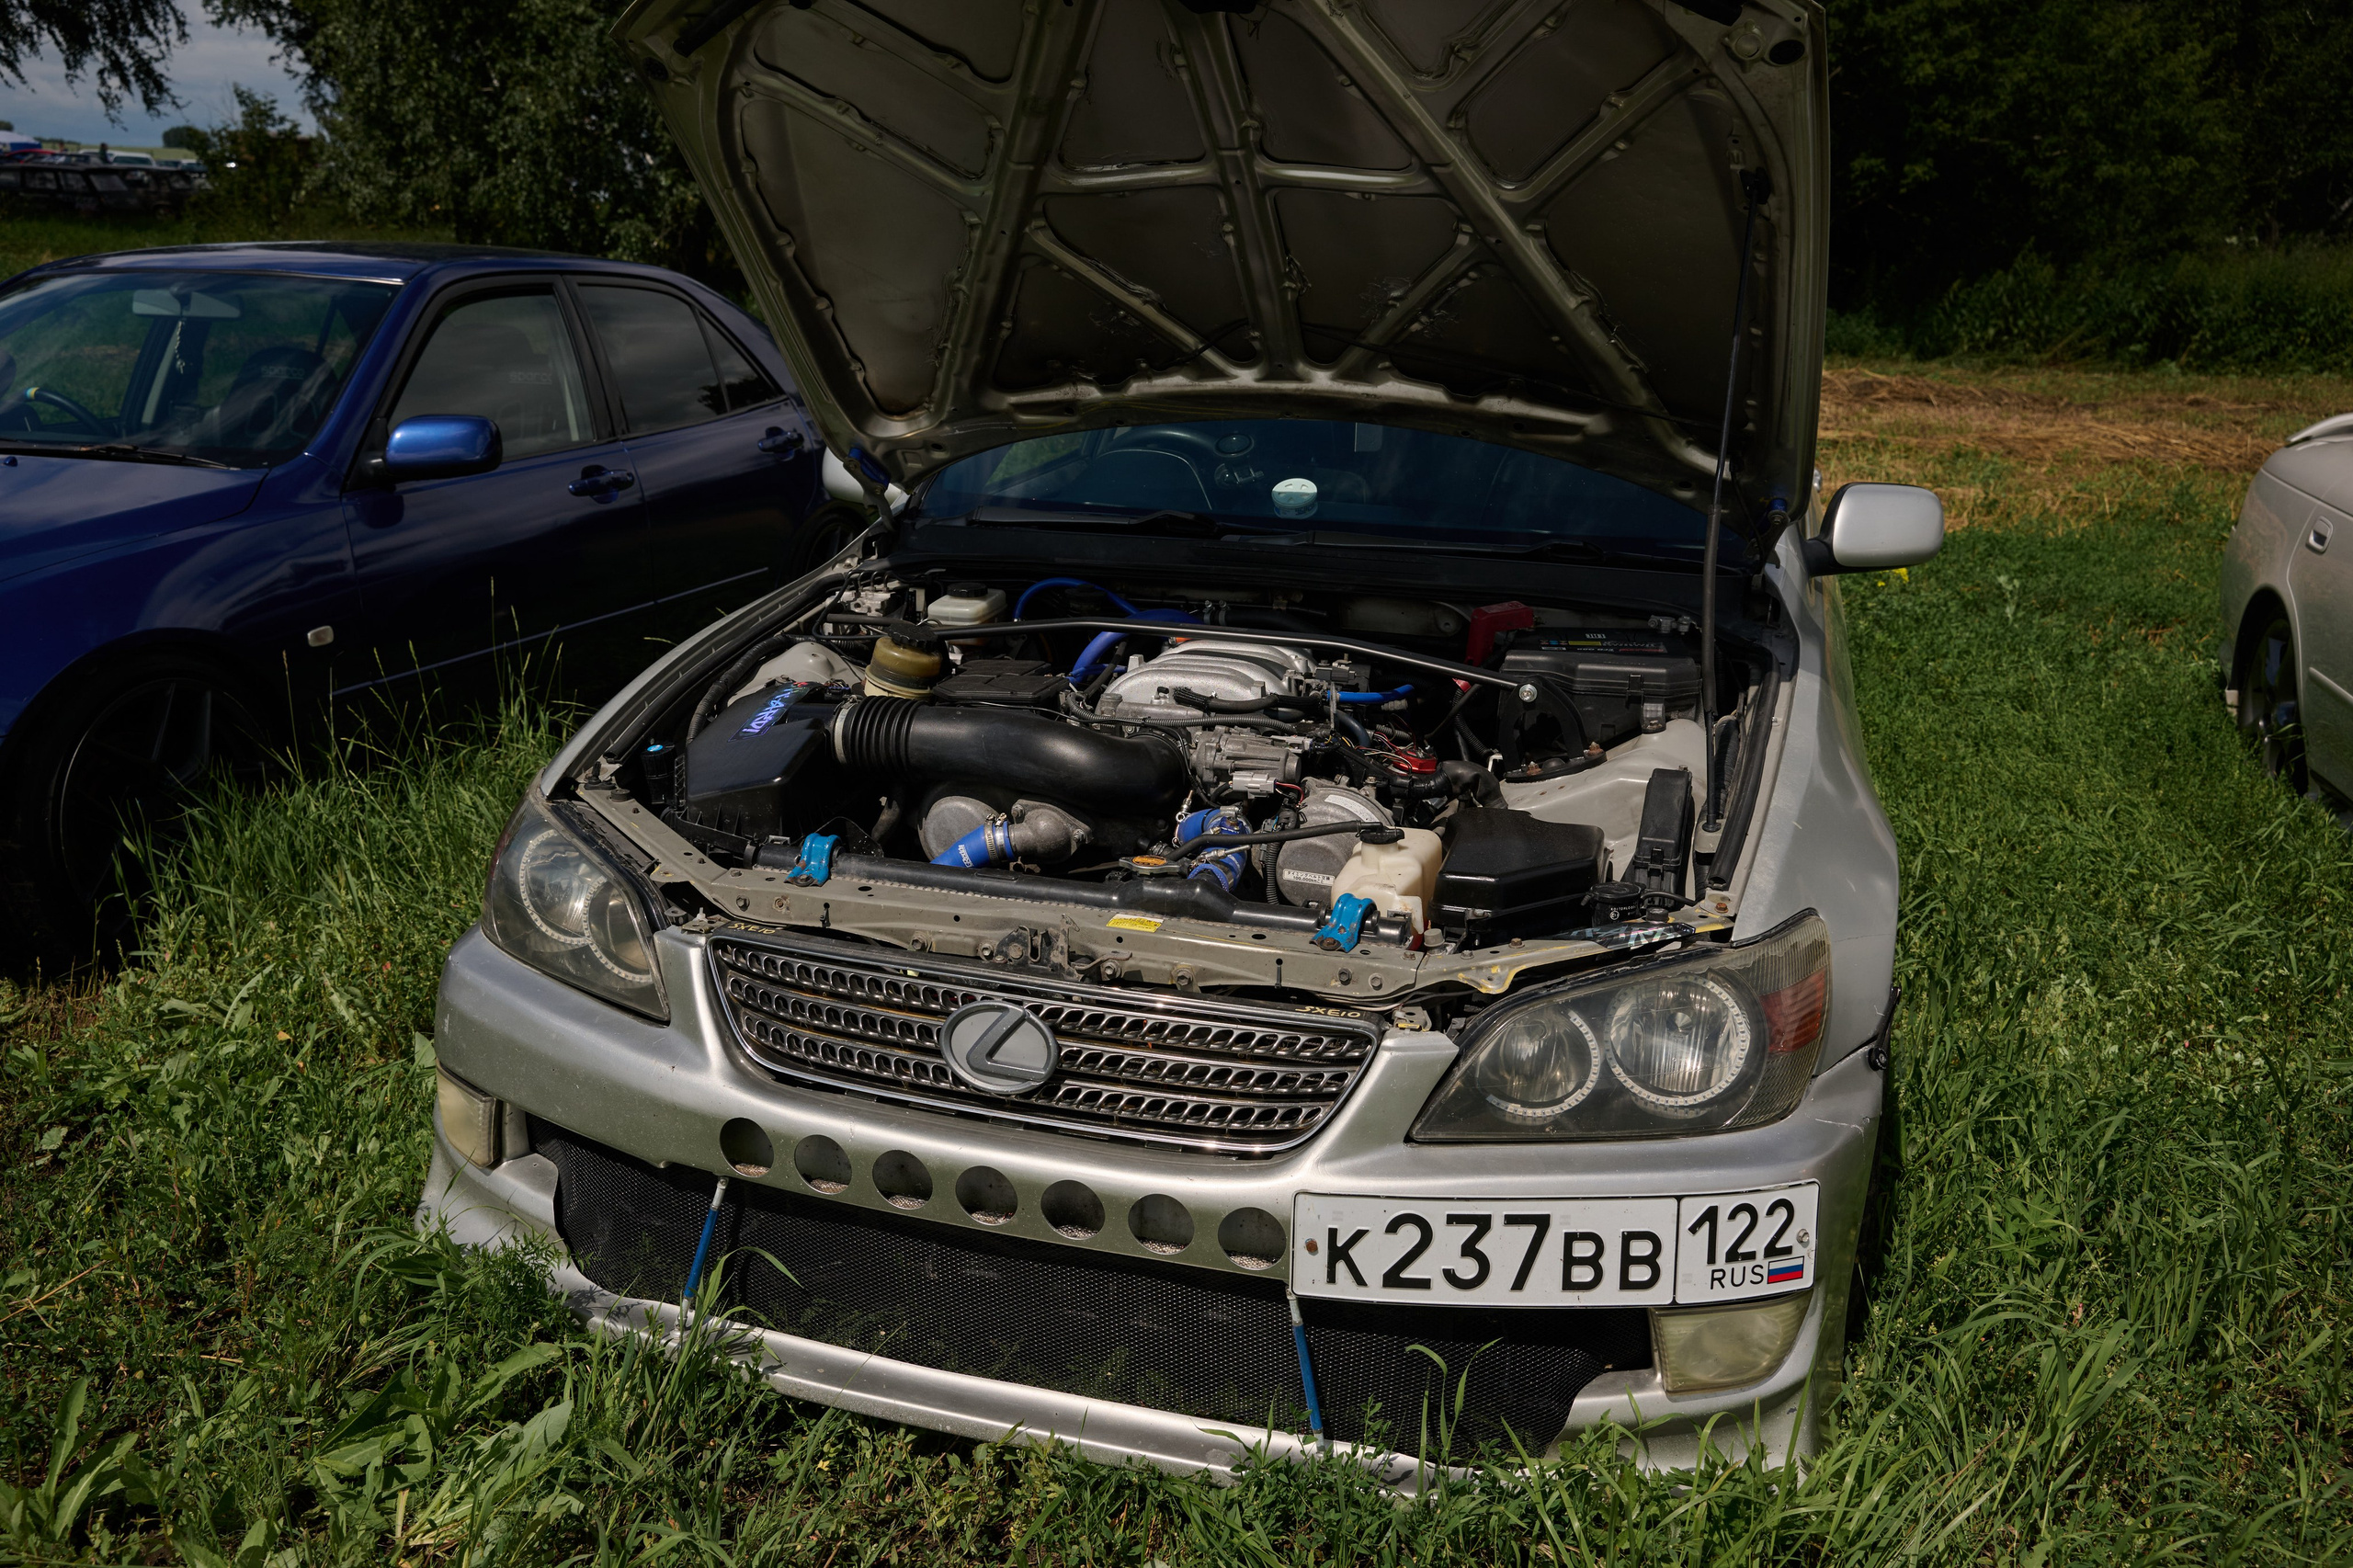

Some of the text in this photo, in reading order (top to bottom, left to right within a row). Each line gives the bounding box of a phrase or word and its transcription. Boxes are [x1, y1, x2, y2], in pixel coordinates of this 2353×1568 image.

[261, 365, 305, 378] sparco
[1294, 1006, 1361, 1018] SXE10
[1325, 1197, 1795, 1291] K237BB 122
[1710, 1264, 1766, 1290] RUS
